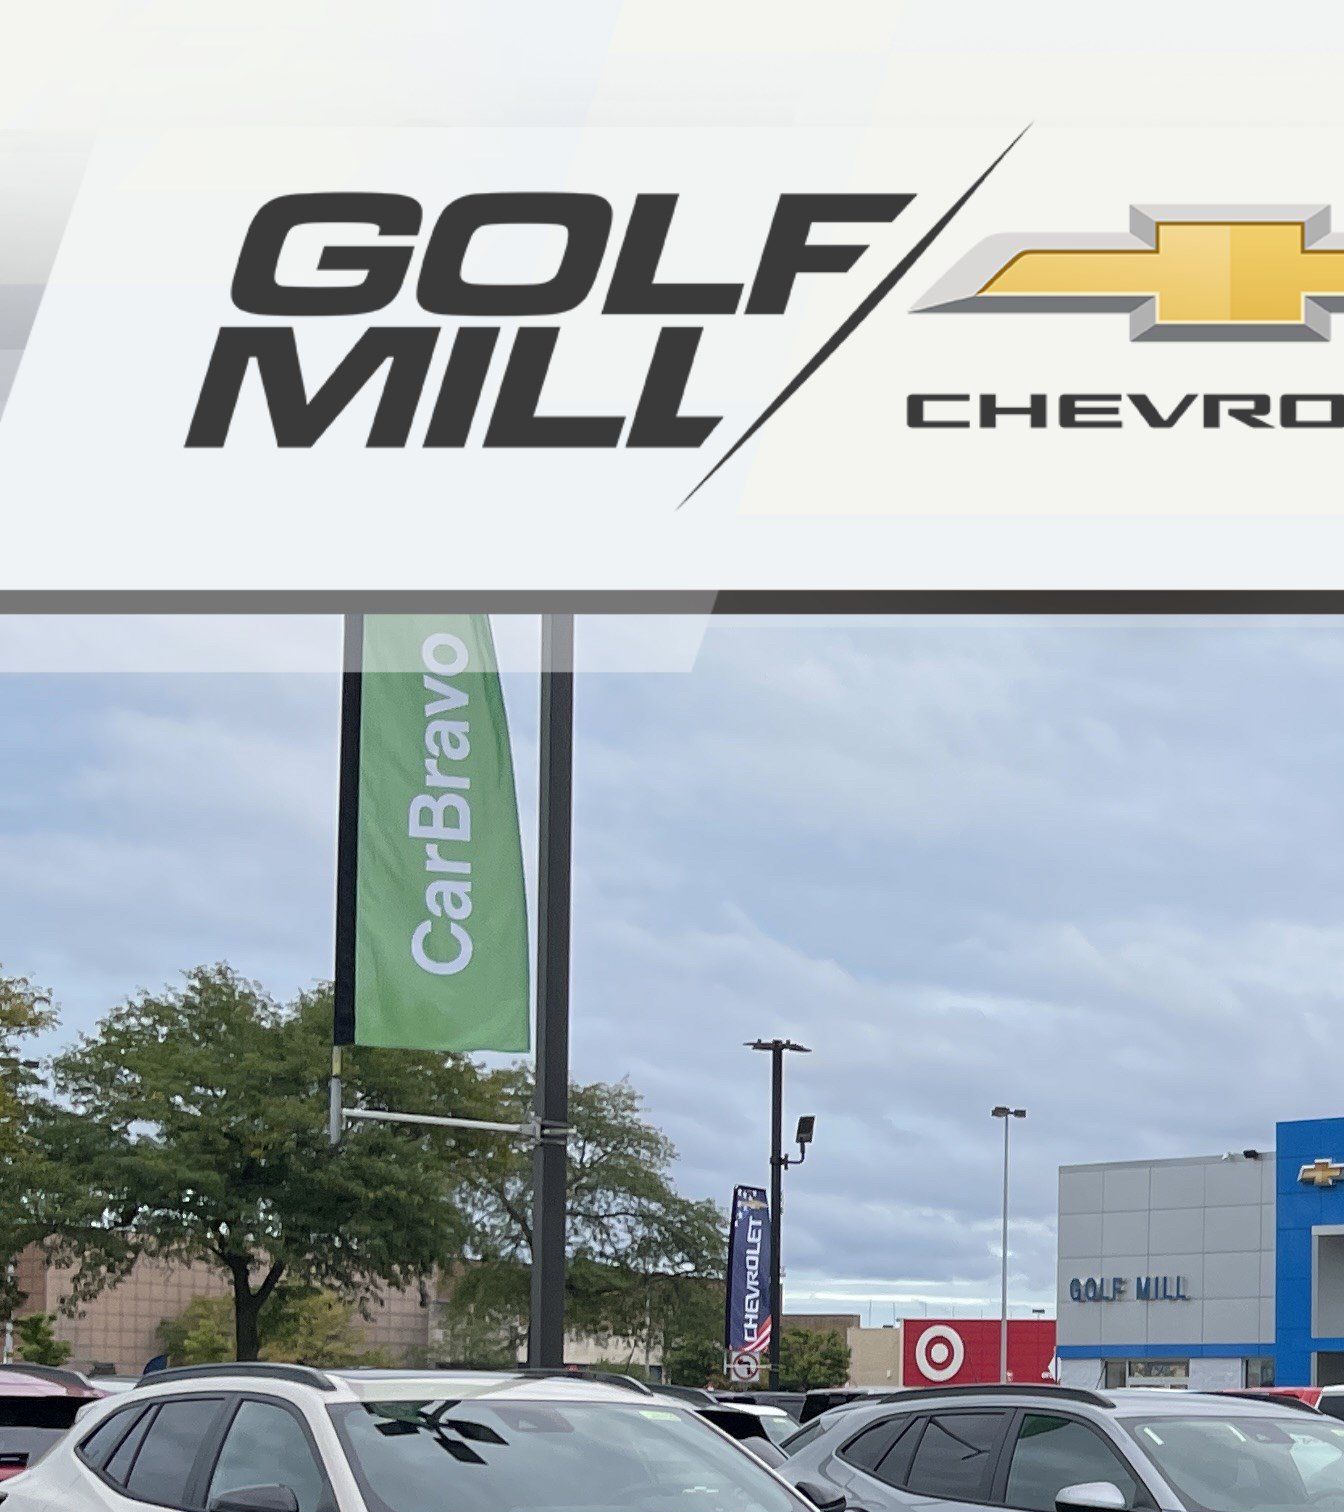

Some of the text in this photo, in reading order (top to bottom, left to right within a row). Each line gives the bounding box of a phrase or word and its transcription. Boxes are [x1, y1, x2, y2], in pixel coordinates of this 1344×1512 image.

[408, 633, 473, 976] CarBravo
[744, 1216, 763, 1343] CHEVROLET
[1070, 1276, 1188, 1302] GOLF MILL
